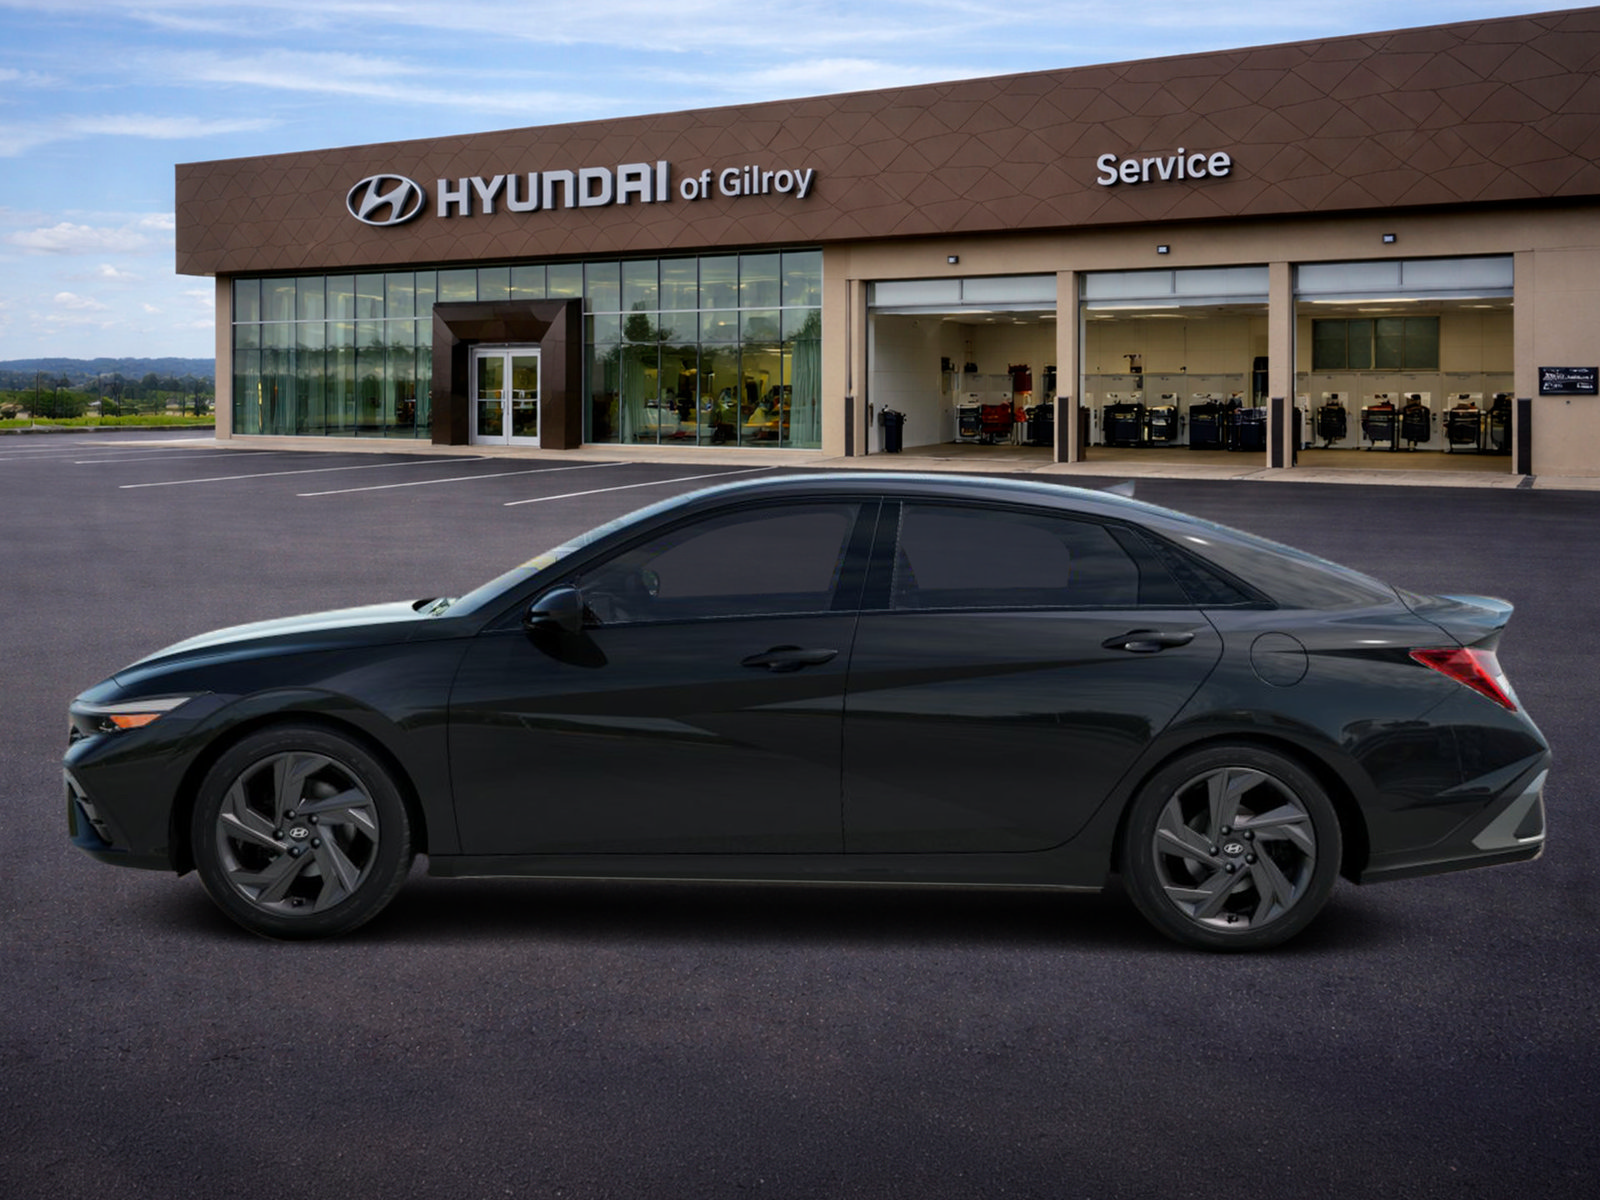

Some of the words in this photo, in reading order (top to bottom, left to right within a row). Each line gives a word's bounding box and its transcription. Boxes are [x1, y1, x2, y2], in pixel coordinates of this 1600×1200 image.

[436, 160, 669, 218] HYUNDAI
[680, 169, 712, 200] of
[719, 165, 813, 198] Gilroy
[1096, 147, 1231, 186] Service
